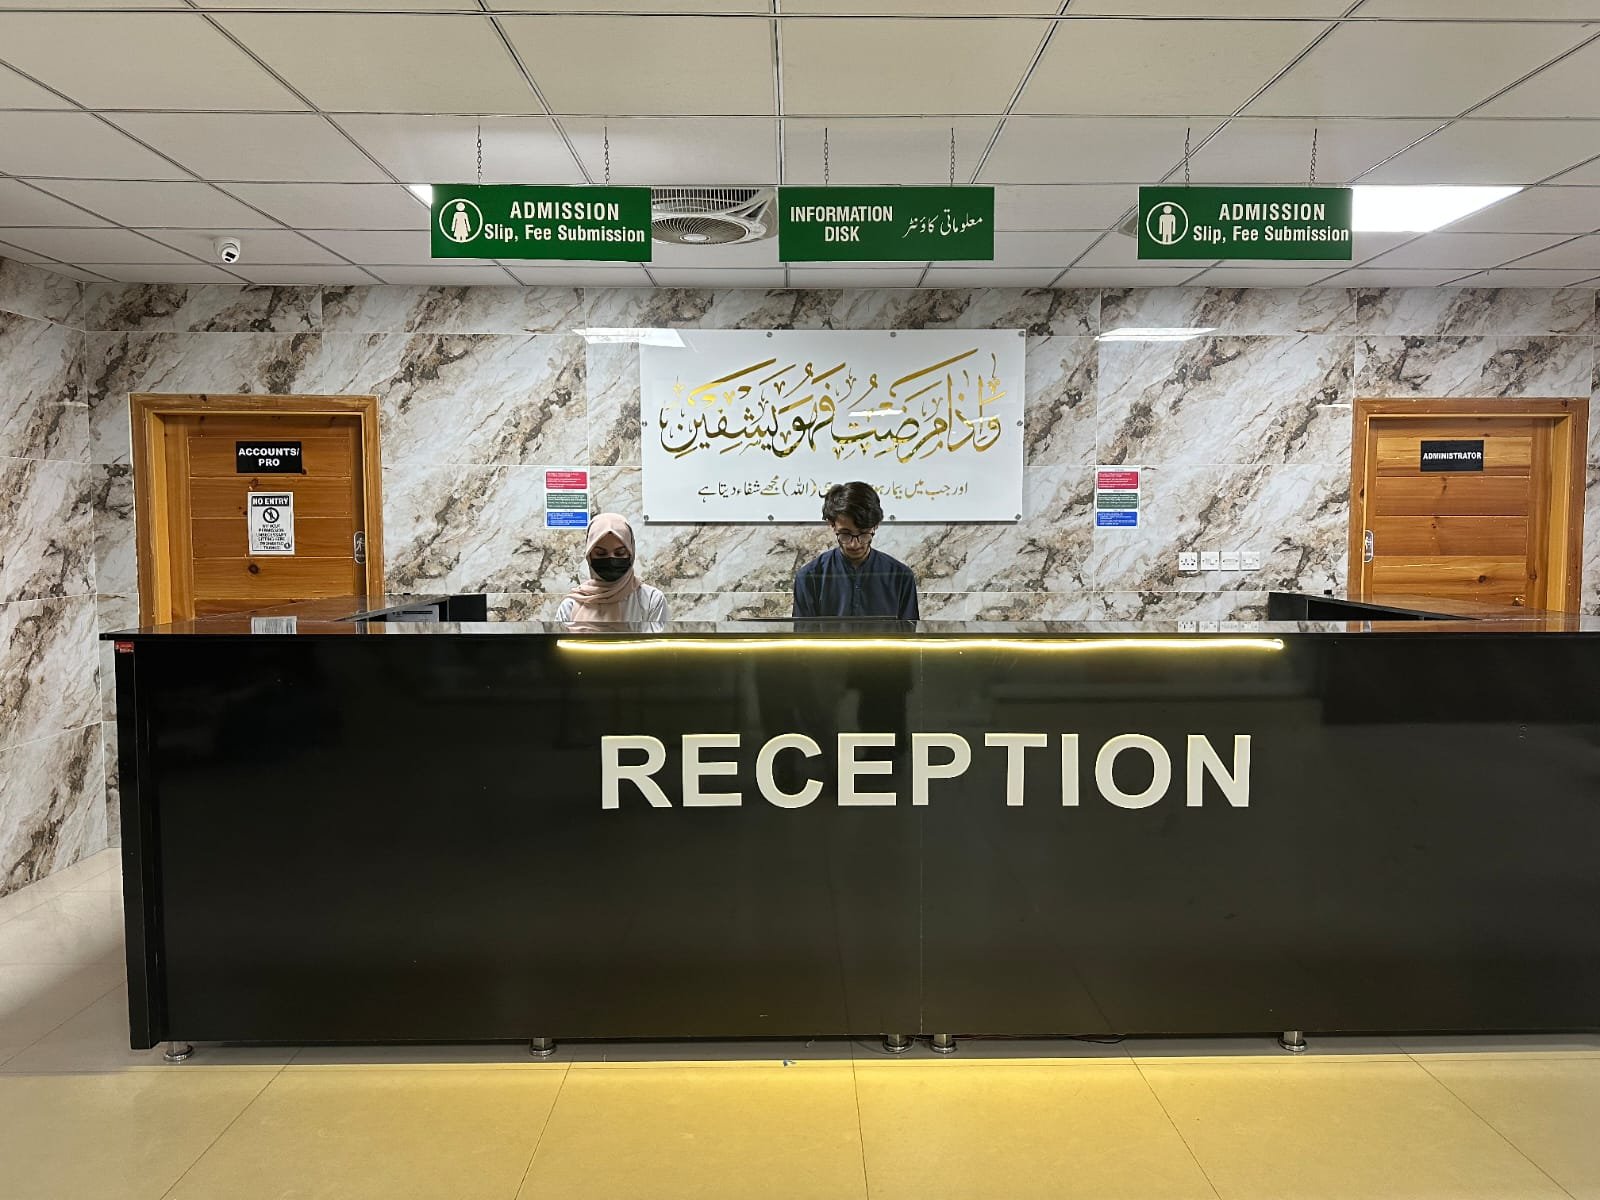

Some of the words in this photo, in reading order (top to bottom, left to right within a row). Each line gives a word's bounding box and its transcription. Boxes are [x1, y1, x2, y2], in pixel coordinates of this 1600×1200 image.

[510, 201, 619, 221] ADMISSION
[790, 205, 893, 222] INFORMATION
[1218, 203, 1326, 221] ADMISSION
[484, 223, 519, 243] Slip,
[525, 224, 552, 241] Fee
[558, 225, 645, 242] Submission
[824, 225, 860, 242] DISK
[1193, 225, 1227, 244] Slip,
[1233, 225, 1259, 241] Fee
[1264, 225, 1349, 242] Submission
[238, 447, 300, 457] ACCOUNTS/
[1422, 451, 1482, 460] ADMINISTRATOR
[258, 458, 280, 467] PRO
[252, 497, 264, 505] NO
[265, 497, 289, 505] ENTRY
[601, 732, 1251, 810] RECEPTION
